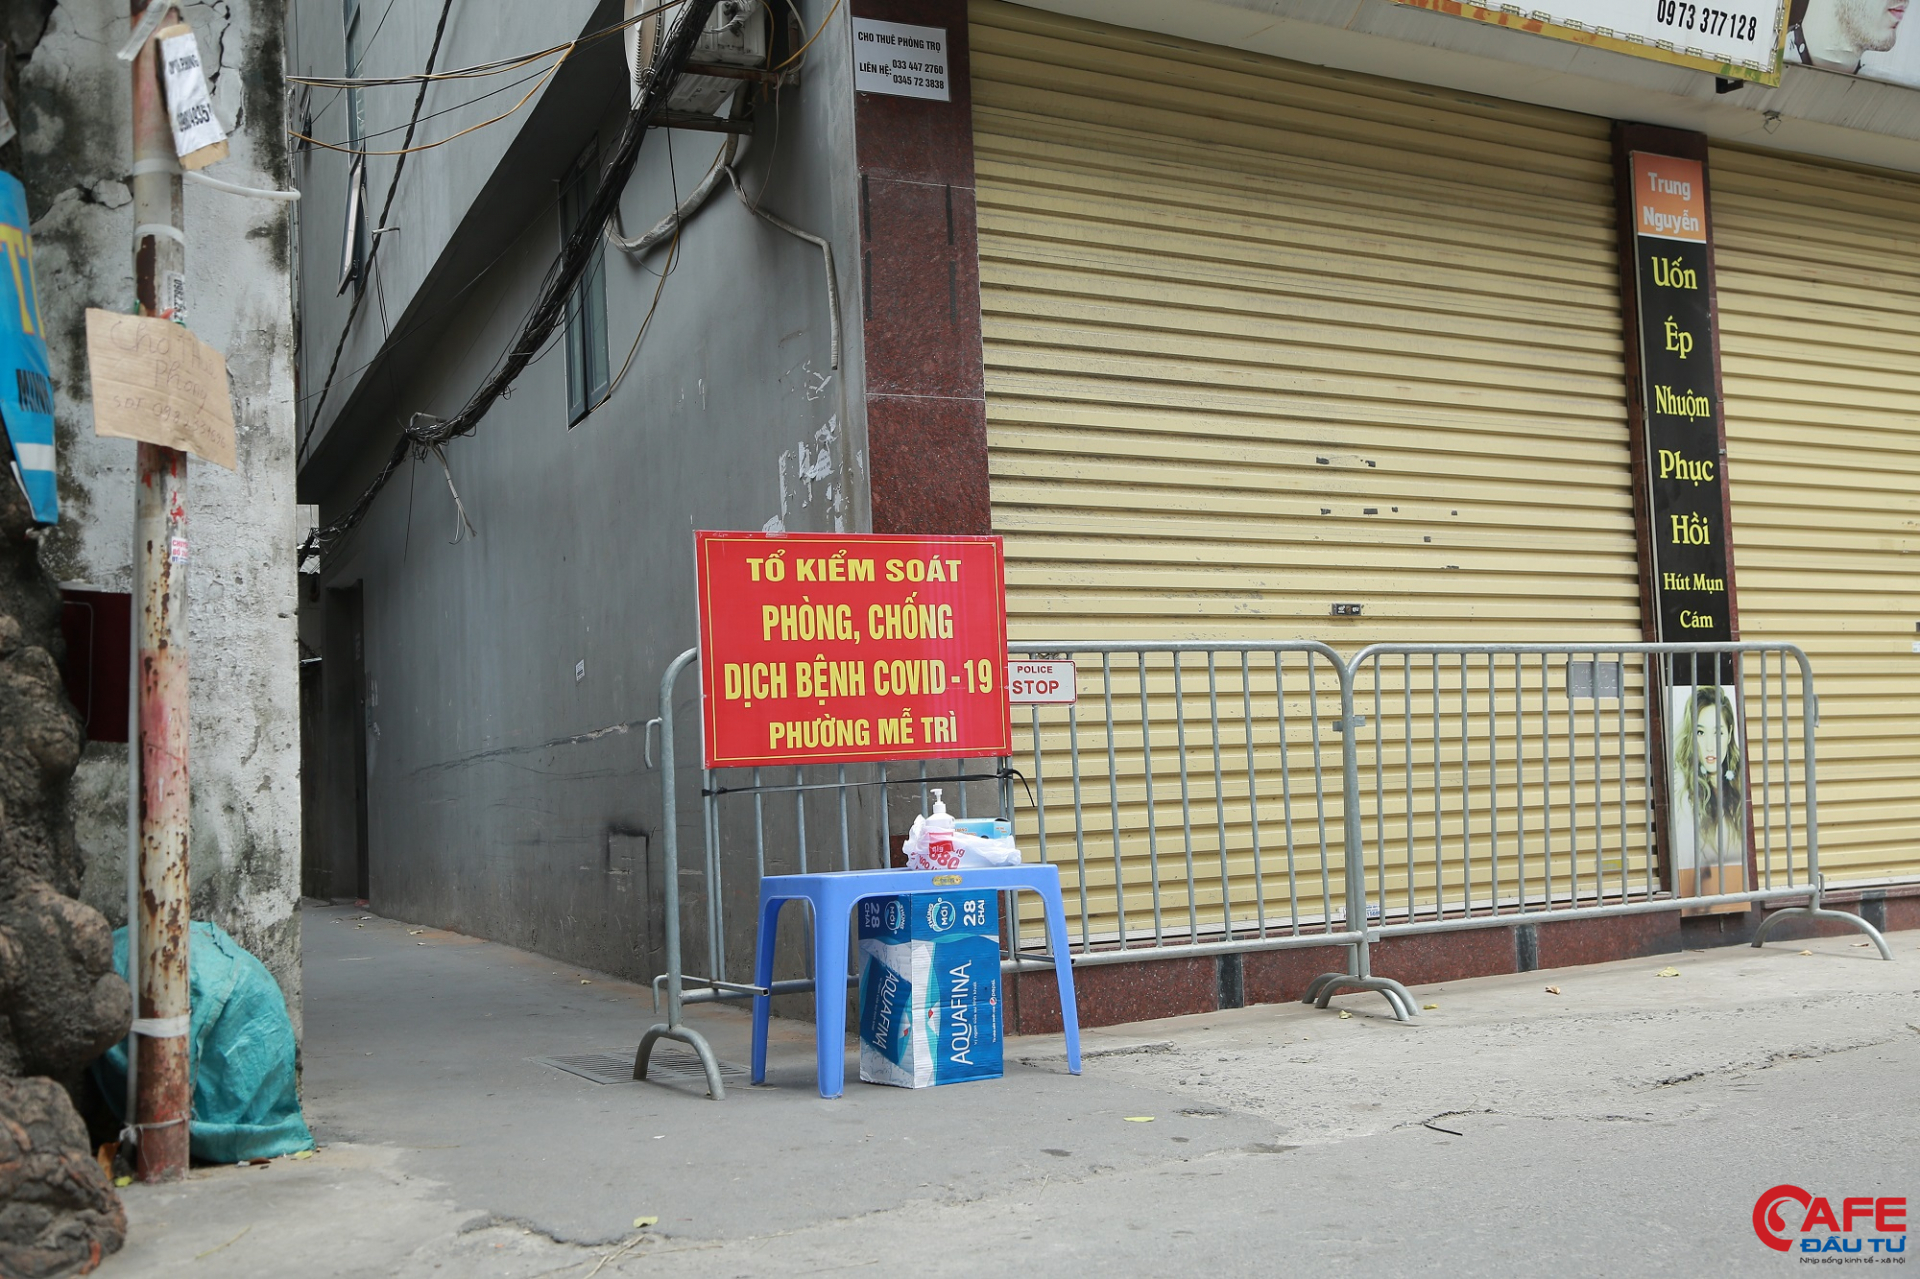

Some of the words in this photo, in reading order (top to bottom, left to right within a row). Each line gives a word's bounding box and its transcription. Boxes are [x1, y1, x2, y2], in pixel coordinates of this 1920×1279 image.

[1657, 0, 1696, 30] 0973
[1700, 8, 1757, 41] 377128
[858, 31, 874, 42] CHO
[876, 34, 896, 45] THUÊ
[897, 36, 924, 49] PHÒNG
[926, 41, 941, 53] TRỌ
[860, 61, 877, 73] LIÊN
[879, 64, 892, 77] HỆ:
[892, 59, 907, 70] 033
[908, 61, 923, 71] 447
[924, 64, 944, 75] 2760
[893, 74, 912, 85] 0345
[914, 77, 923, 87] 72
[925, 79, 944, 89] 3838
[1648, 172, 1691, 201] Trung
[1643, 206, 1699, 234] Nguyễn
[1652, 256, 1697, 290] Uốn
[110, 321, 170, 355] Cho
[1664, 315, 1693, 360] Ép
[1655, 385, 1710, 422] Nhuộm
[1659, 449, 1714, 486] Phục
[1671, 511, 1710, 545] Hồi
[746, 549, 785, 582] TỔ
[797, 549, 875, 582] KIỂM
[885, 555, 961, 582] SOÁT
[1663, 572, 1690, 590] Hút
[1693, 573, 1724, 594] Mụn
[762, 595, 861, 644] PHÒNG,
[868, 592, 953, 640] CHỐNG
[1680, 610, 1713, 628] Cám
[724, 661, 787, 708] DỊCH
[797, 653, 866, 705] BỆNH
[1017, 665, 1053, 674] POLICE
[1012, 680, 1059, 695] STOP
[769, 713, 870, 749] PHƯỜNG
[878, 708, 914, 745] MỄ
[920, 710, 958, 743] TRÌ
[870, 902, 880, 929] 28
[940, 906, 948, 926] MỚI
[963, 900, 976, 927] 28
[977, 899, 985, 925] CHAI
[872, 969, 900, 1050] AQUAFINA
[949, 959, 974, 1066] AQUAFINA
